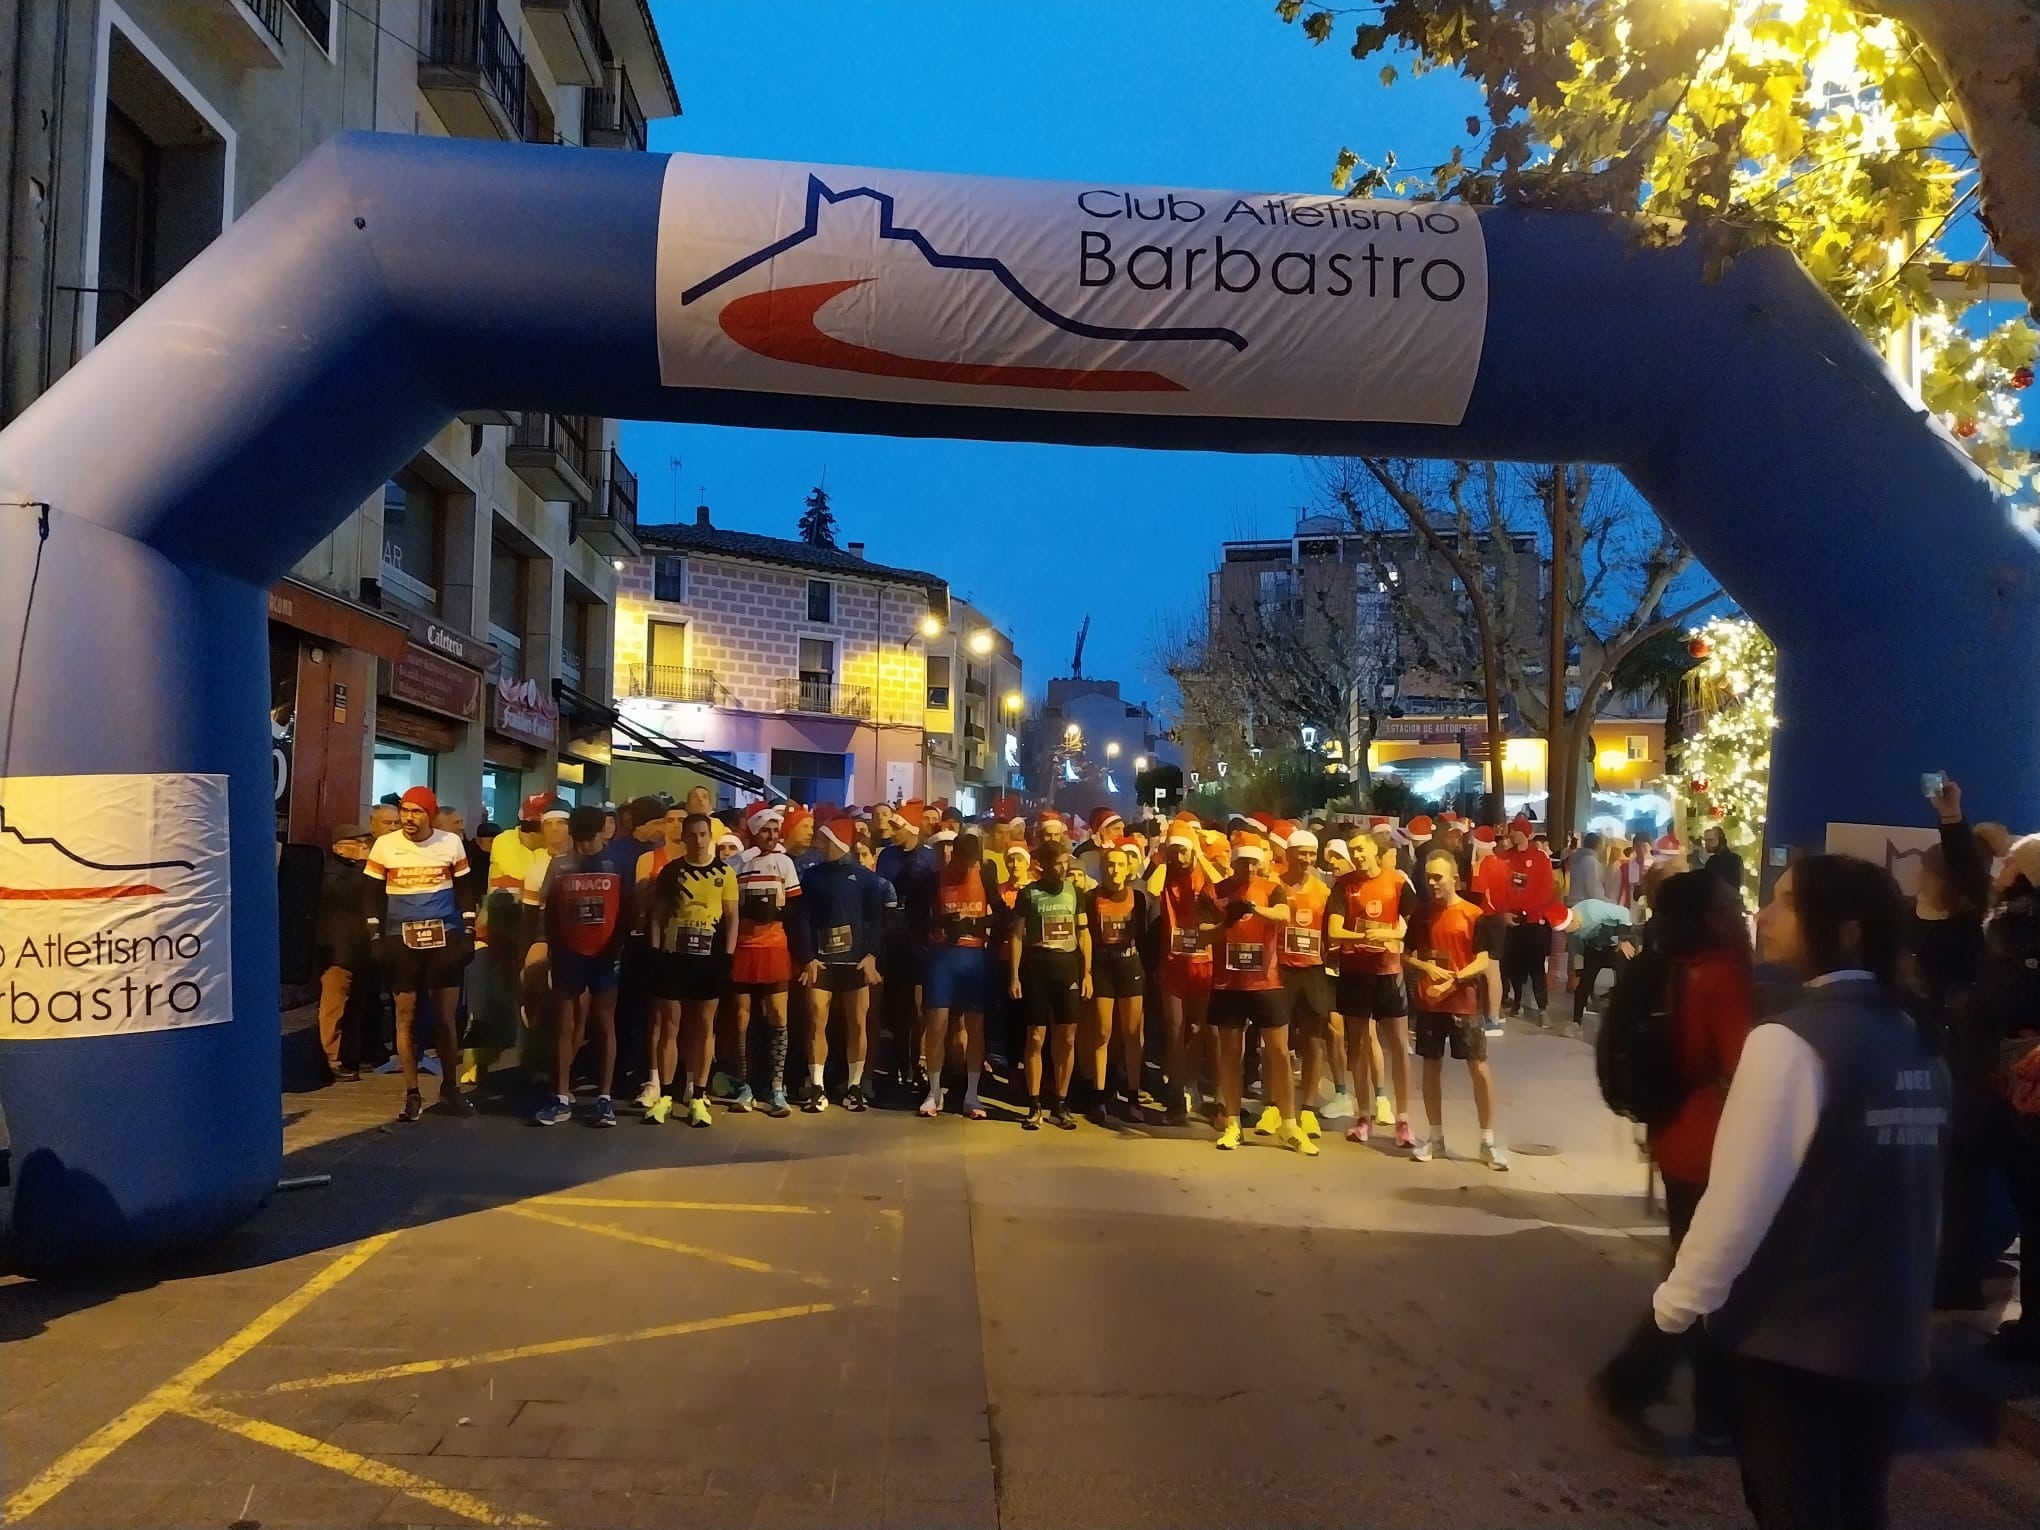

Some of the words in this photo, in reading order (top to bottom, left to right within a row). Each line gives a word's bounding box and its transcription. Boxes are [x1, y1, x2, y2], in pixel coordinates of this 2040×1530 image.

[1078, 190, 1206, 223] Club
[1223, 199, 1460, 234] Atletismo
[1079, 230, 1466, 302] Barbastro
[1423, 723, 1433, 733] DE
[14, 930, 201, 969] Atletismo
